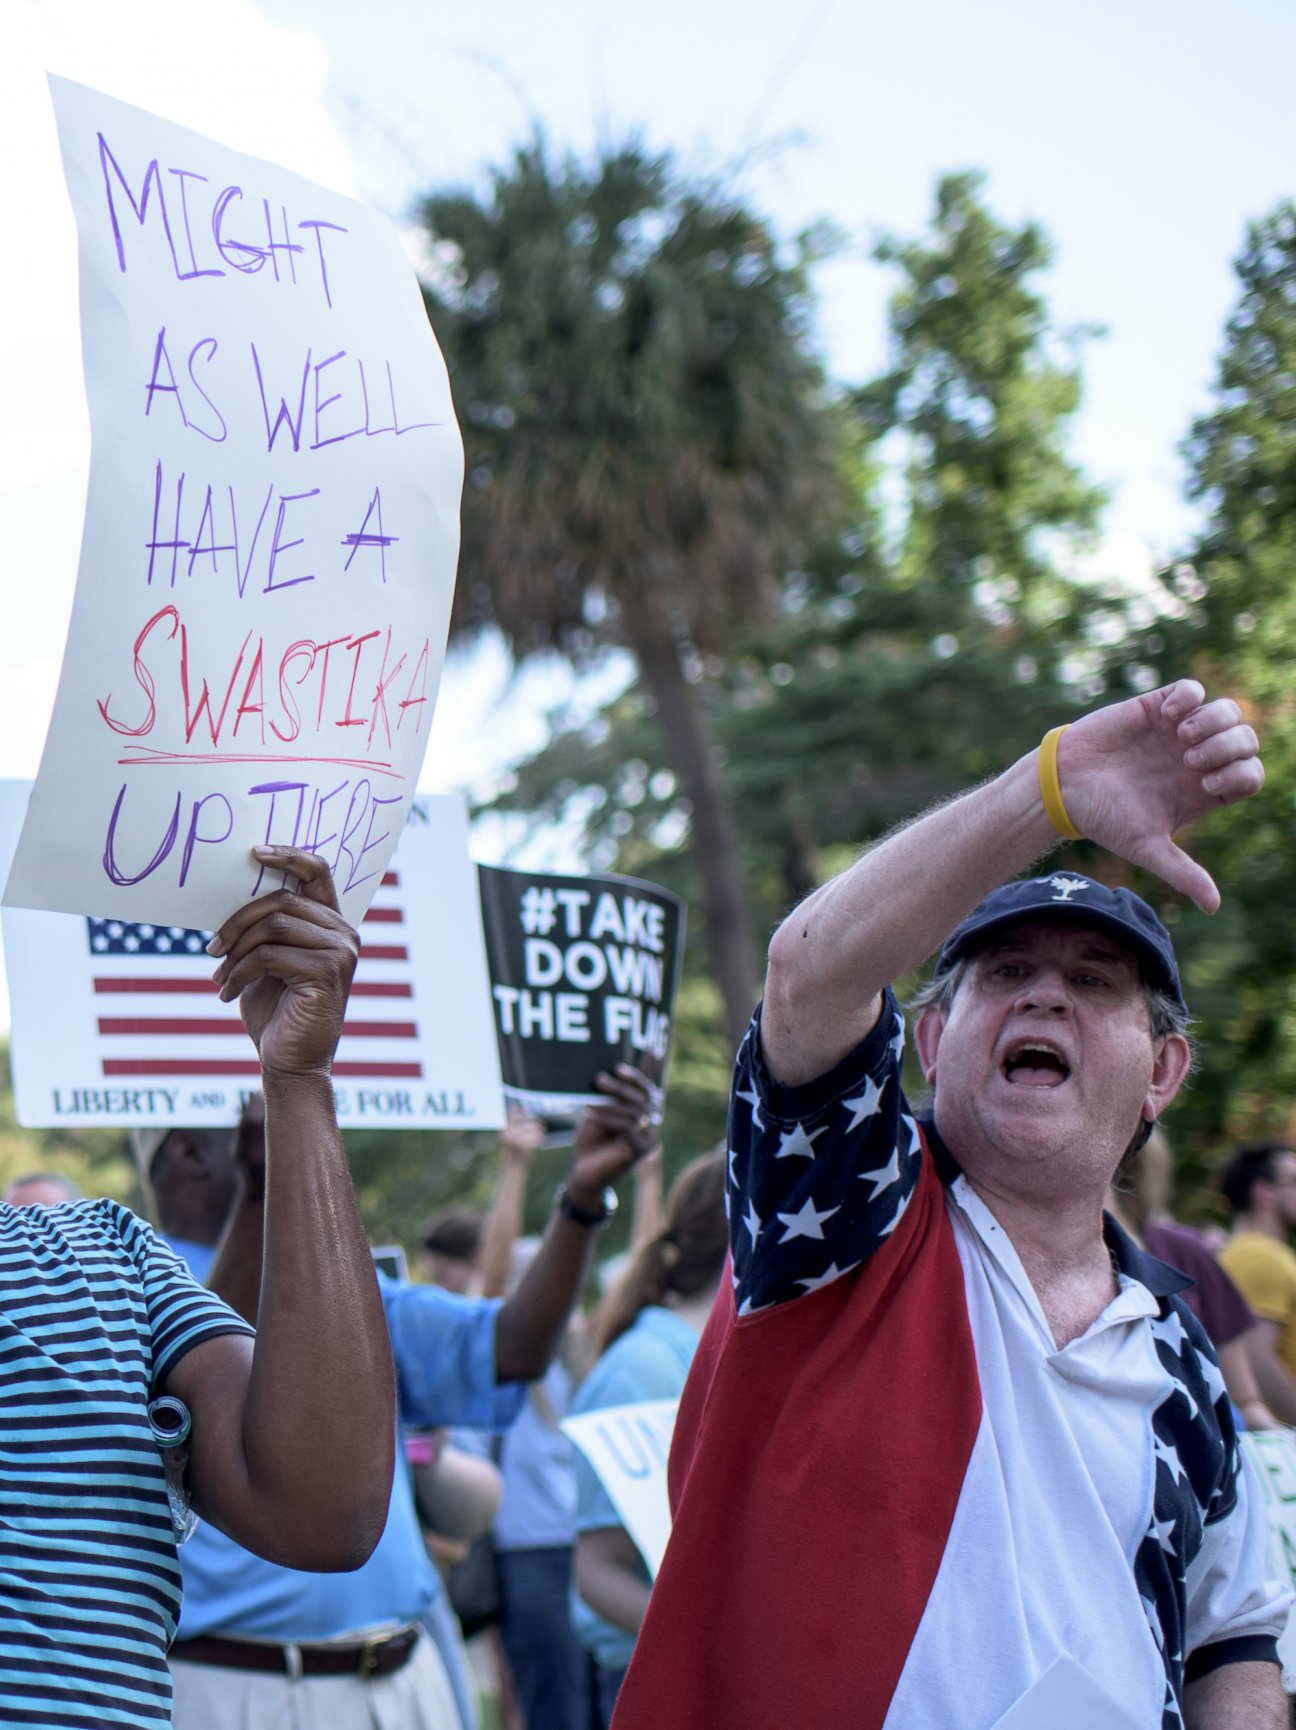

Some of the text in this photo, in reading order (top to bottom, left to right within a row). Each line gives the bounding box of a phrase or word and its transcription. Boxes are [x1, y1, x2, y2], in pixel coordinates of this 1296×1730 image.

[97, 131, 349, 309] MIGHT
[145, 326, 445, 453] AS WELL
[145, 457, 400, 599] HAVE A
[96, 604, 430, 752] SWASTIKA
[103, 784, 234, 888] UP
[519, 885, 666, 954] #TAKE
[524, 937, 665, 1004] DOWN
[493, 983, 591, 1043] THE
[52, 1089, 178, 1115] LIBERTY
[189, 1093, 226, 1110] AND
[357, 1089, 413, 1116] FOR
[423, 1089, 476, 1117] ALL
